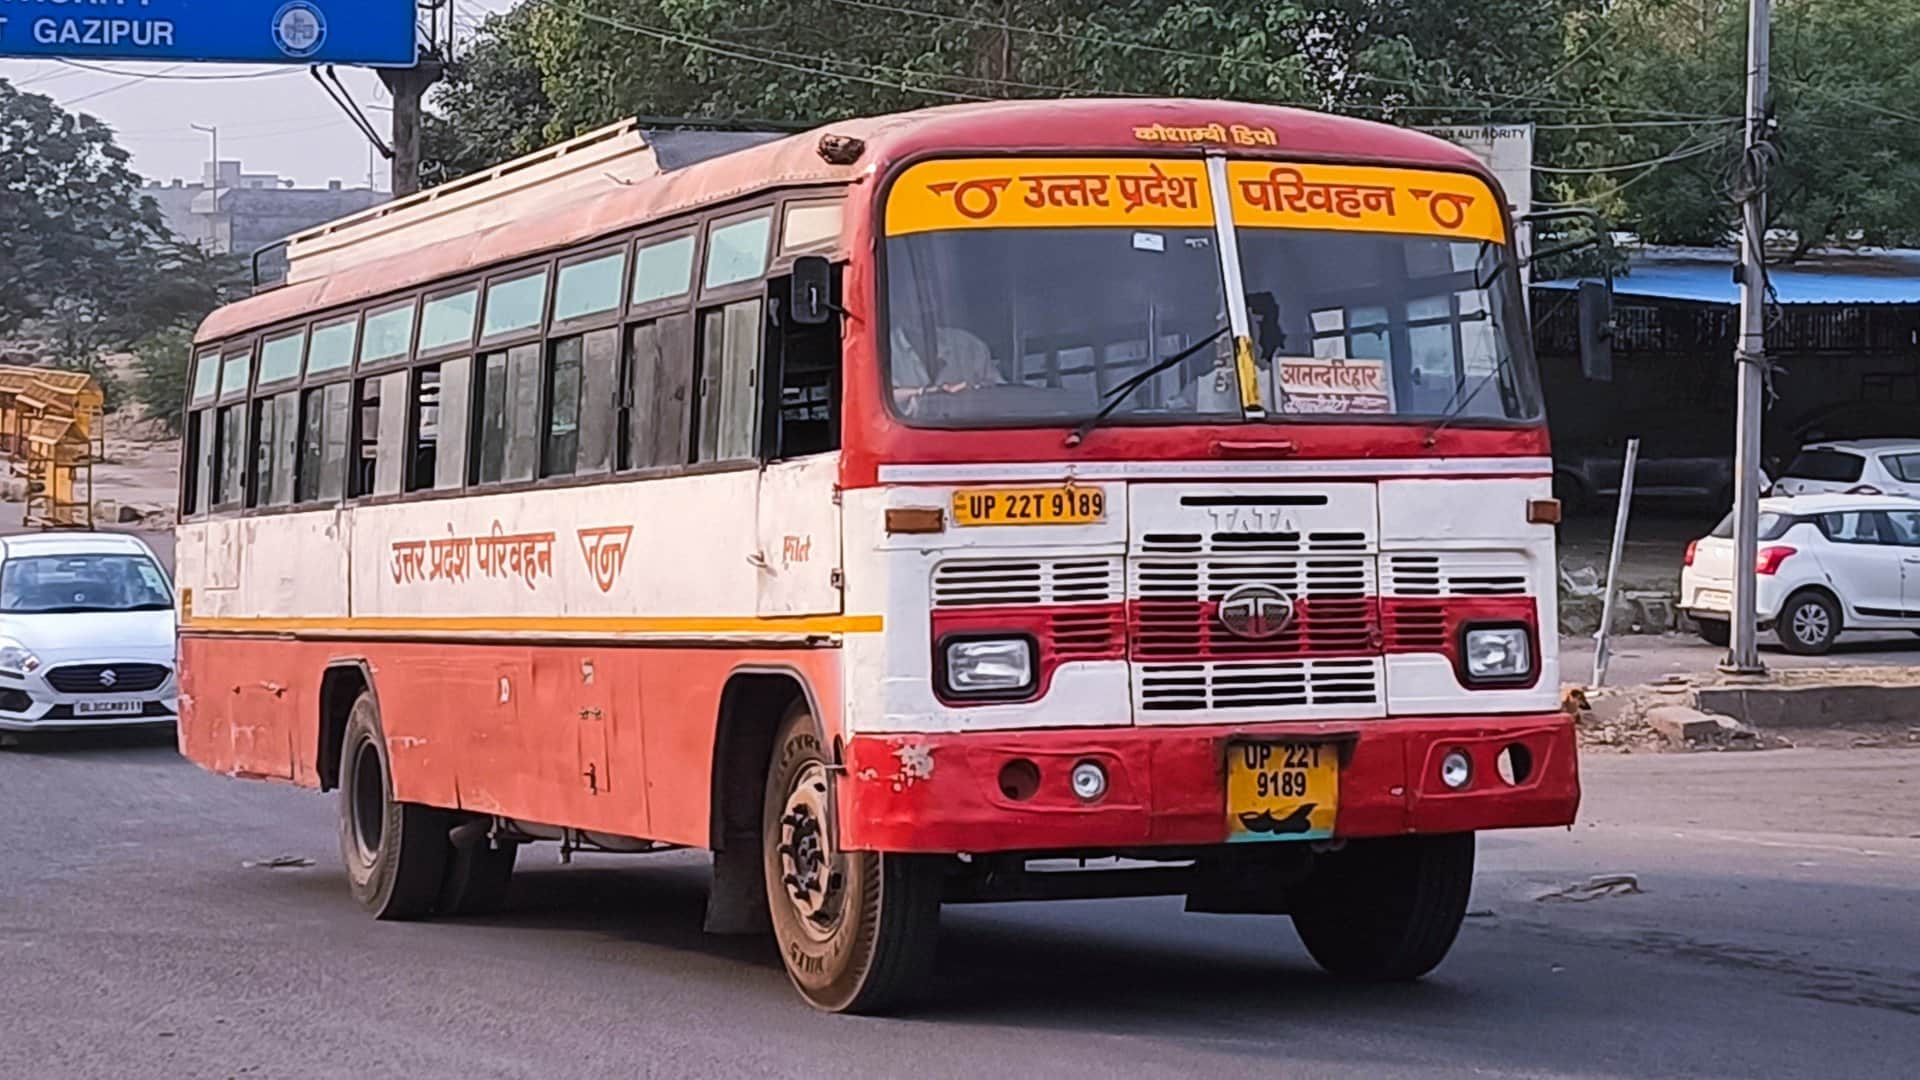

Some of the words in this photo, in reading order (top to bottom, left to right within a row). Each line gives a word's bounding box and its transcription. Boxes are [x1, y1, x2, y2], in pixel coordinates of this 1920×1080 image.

[33, 18, 174, 46] GAZIPUR
[1230, 124, 1278, 146] डिपो
[1459, 128, 1526, 140] AUTHORITY
[1019, 175, 1110, 208] उत्तर
[1115, 163, 1198, 214] प्रदेश
[1238, 167, 1396, 218] परिवहन
[970, 495, 996, 519] UP
[1005, 494, 1045, 518] 22T
[1052, 491, 1103, 517] 9189
[1207, 507, 1293, 531] TATA
[390, 540, 426, 584] उत्तर
[429, 522, 473, 584] प्रदेश
[474, 519, 556, 590] परिवहन
[1244, 743, 1270, 770] UP
[1283, 743, 1321, 769] 22T
[1256, 770, 1307, 797] 9189
